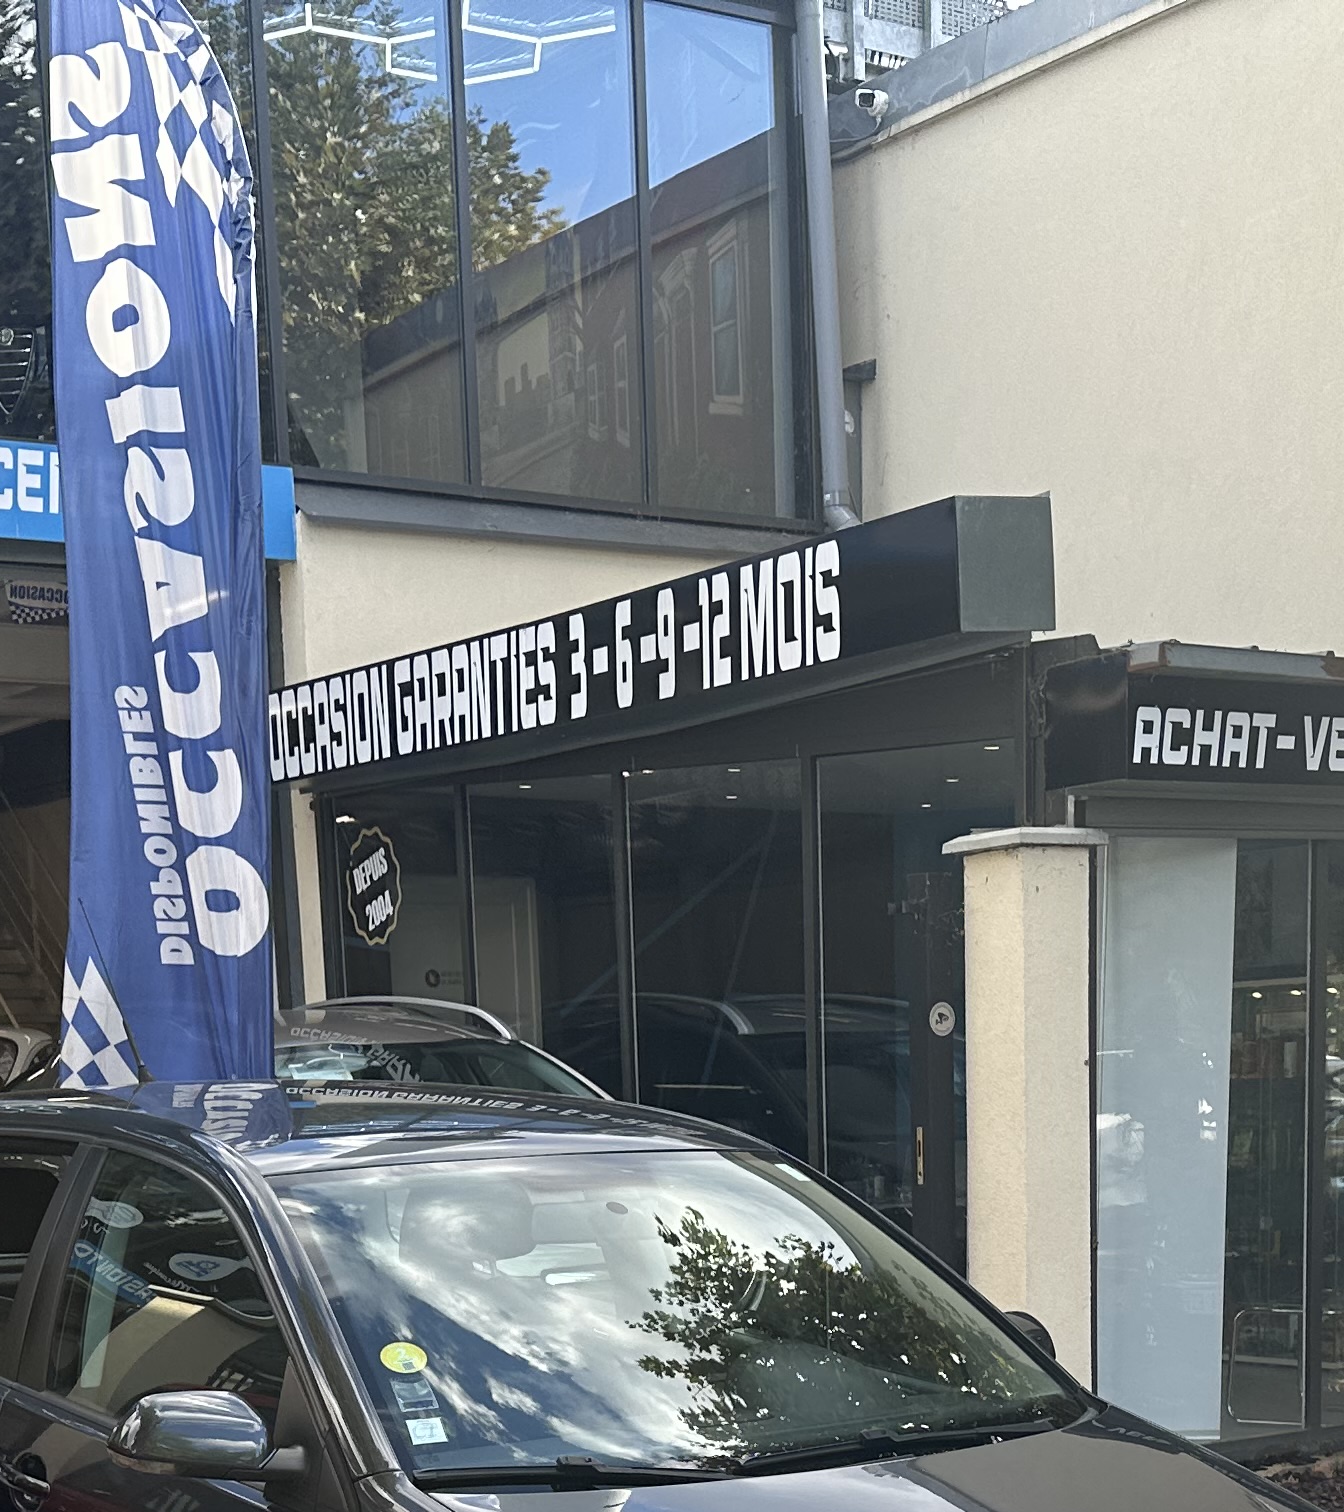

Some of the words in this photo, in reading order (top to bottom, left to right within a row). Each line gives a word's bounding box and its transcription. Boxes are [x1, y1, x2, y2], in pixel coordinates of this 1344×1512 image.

[268, 664, 391, 782] OCCASION
[394, 621, 557, 756] GARANTIES
[739, 539, 841, 681] MOIS
[353, 847, 388, 895] DEPUIS
[365, 889, 394, 931] 2004
